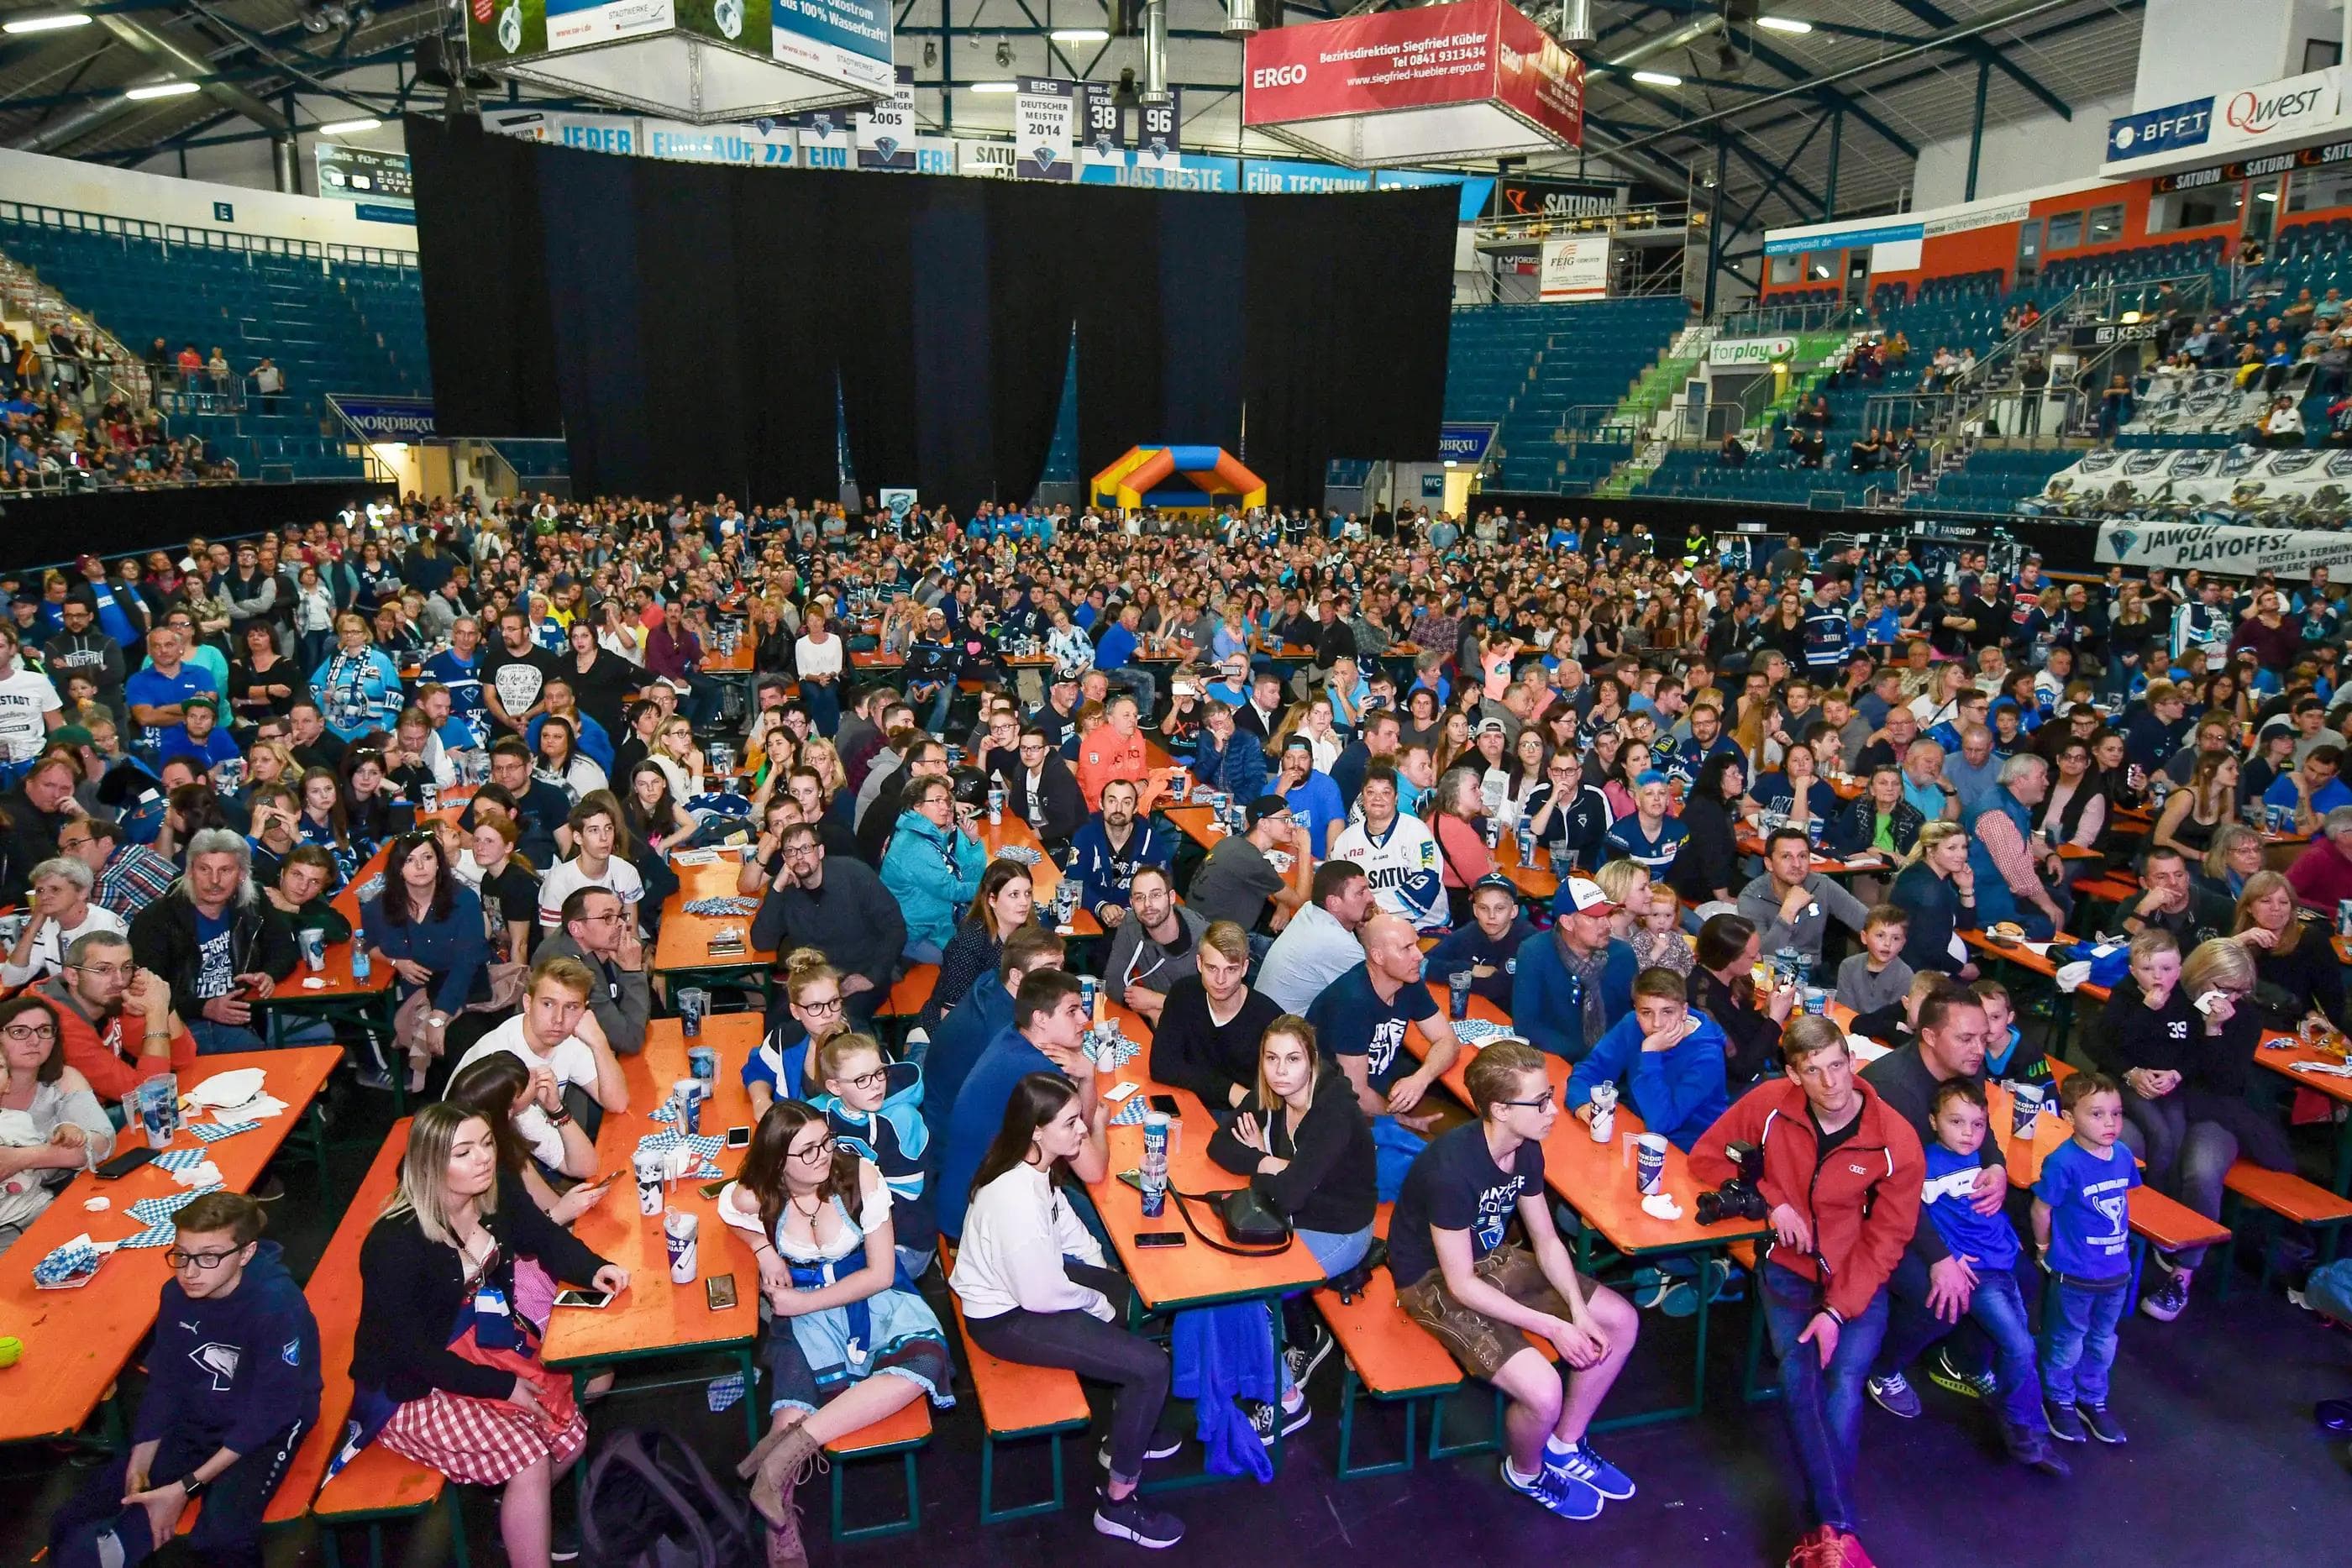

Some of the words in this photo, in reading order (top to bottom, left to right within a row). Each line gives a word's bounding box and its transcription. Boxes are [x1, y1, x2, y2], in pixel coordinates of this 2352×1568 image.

[608, 4, 648, 20] STADTWERKE
[801, 2, 827, 23] 100%
[829, 11, 887, 43] Wasserkraft!
[1320, 45, 1400, 64] Bezirksdirektion
[1403, 37, 1450, 55] Siegfried
[1452, 32, 1488, 47] Kübler
[1393, 55, 1408, 69] Tel
[1410, 51, 1436, 66] 0841
[1438, 46, 1487, 64] 9313434
[1253, 64, 1308, 89] ERGO
[1347, 61, 1486, 87] www.siegfried-kuebler.ergo.de
[1031, 81, 1058, 91] ERC
[1021, 100, 1068, 111] DEUTSCHER
[869, 112, 903, 126] 2005
[1026, 112, 1064, 122] MEISTER
[1090, 106, 1117, 129] 38
[1147, 109, 1172, 133] 96
[2143, 110, 2208, 142] BFFT
[1028, 123, 1061, 136] 2014
[975, 146, 1016, 166] SATU
[2245, 154, 2296, 178] SATURN
[2176, 168, 2222, 190] SATURN
[218, 204, 229, 220] E
[1551, 257, 1575, 267] FEIG
[1713, 342, 1769, 363] forplay
[1424, 478, 1442, 487] WC
[1940, 526, 1977, 537] FANSHOP
[2176, 533, 2294, 564] PLAYOFFS!
[2258, 550, 2297, 565] TICKETS
[2309, 543, 2352, 559] TERMIN
[0, 695, 30, 708] STADT
[1368, 866, 1413, 890] SATU
[2166, 1020, 2187, 1039] 39
